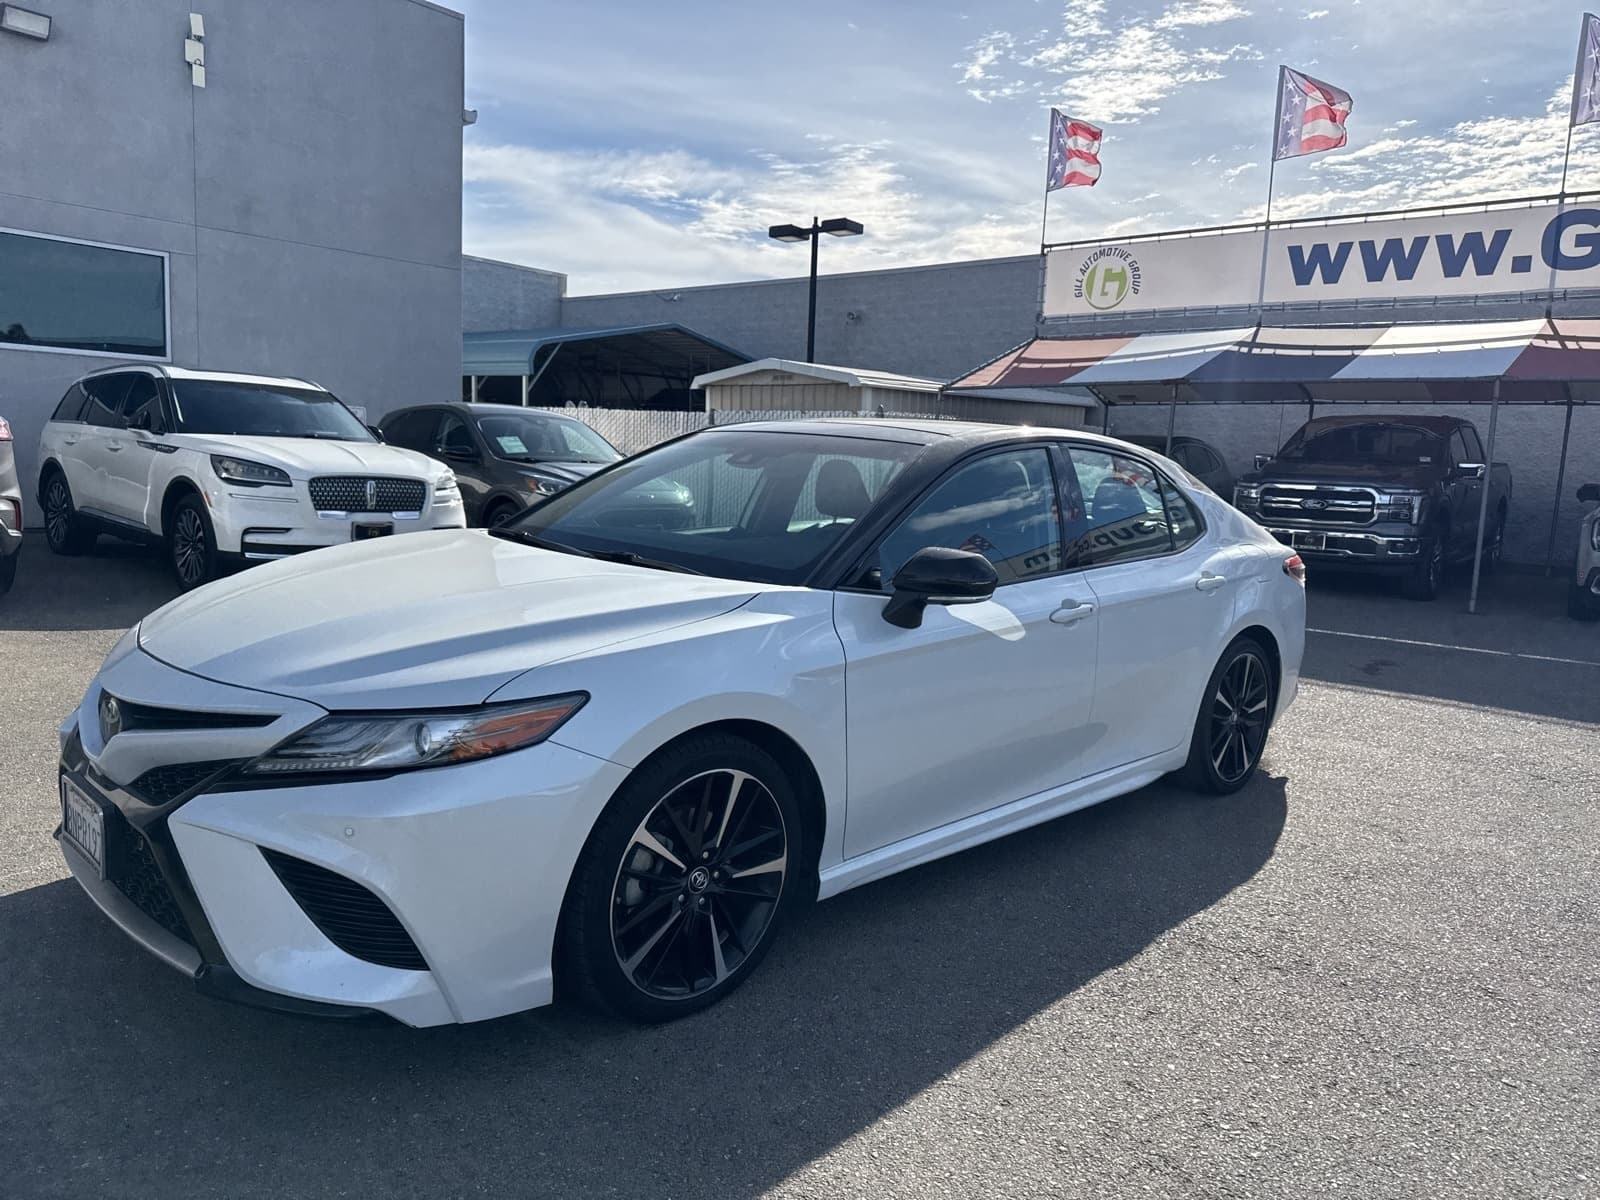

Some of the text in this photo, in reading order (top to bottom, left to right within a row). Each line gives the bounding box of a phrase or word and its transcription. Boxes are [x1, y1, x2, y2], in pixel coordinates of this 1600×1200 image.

[1074, 247, 1141, 298] GILL AUTOMOTIVE GROUP
